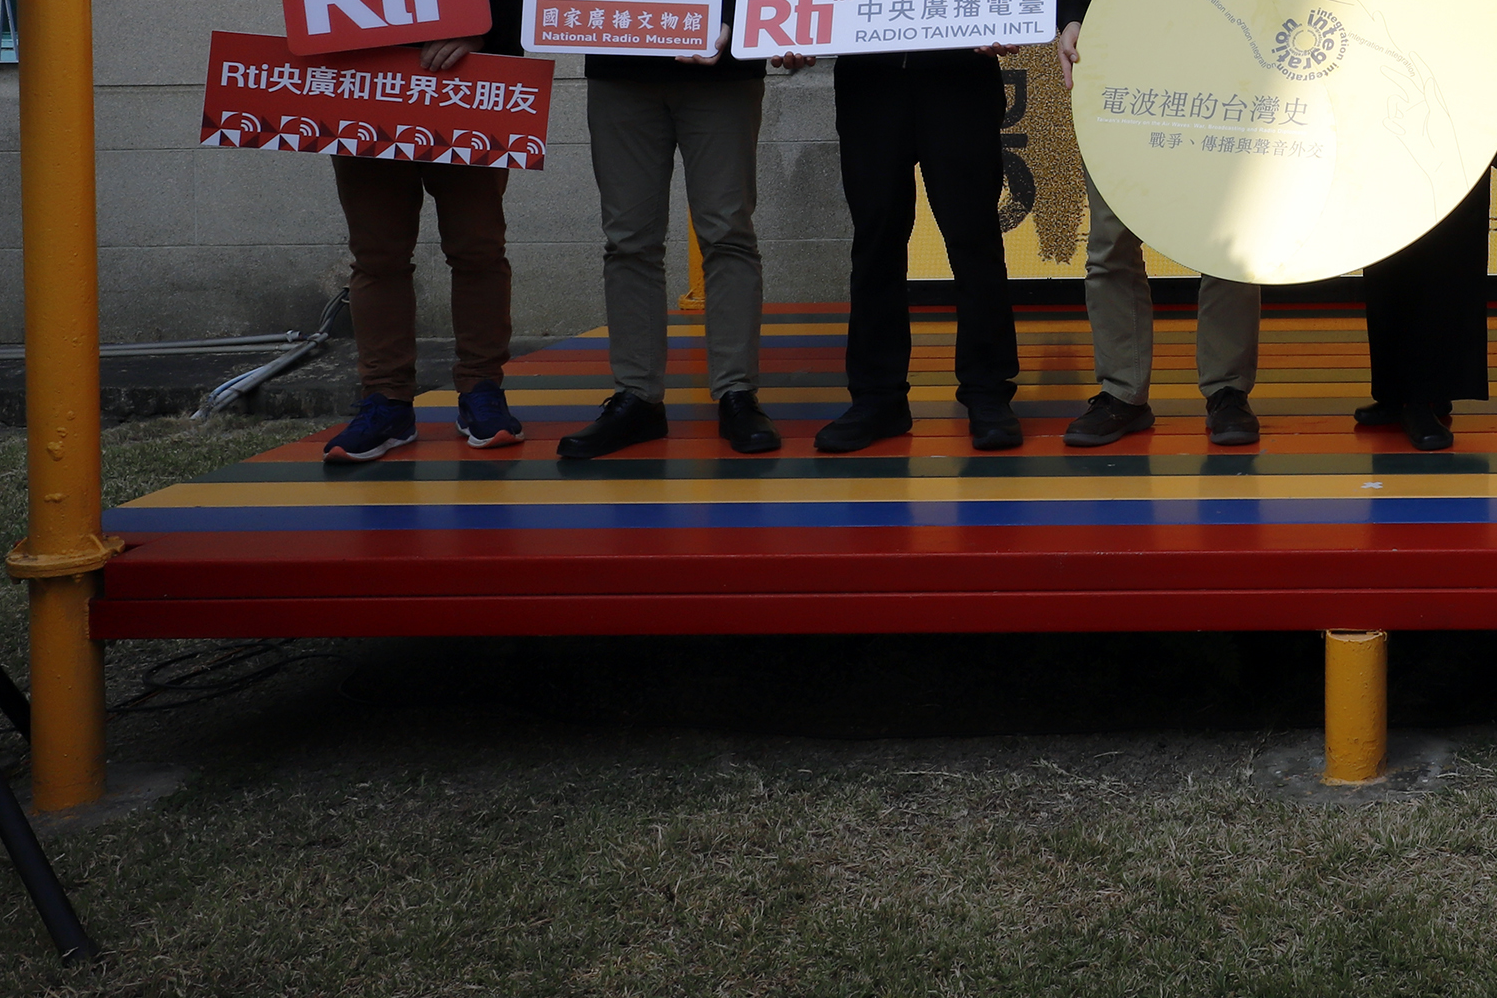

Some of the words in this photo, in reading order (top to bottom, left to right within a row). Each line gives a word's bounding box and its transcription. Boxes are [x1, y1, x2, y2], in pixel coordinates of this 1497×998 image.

[542, 7, 703, 32] 國家廣播文物館
[855, 27, 918, 43] RADIO
[921, 23, 996, 39] TAIWAN
[1003, 21, 1045, 35] INTL
[542, 31, 597, 42] National
[602, 33, 640, 43] Radio
[645, 34, 703, 45] Museum
[220, 61, 539, 115] Rti央廣和世界交朋友
[1101, 86, 1309, 127] 電波裡的台灣史
[1148, 131, 1324, 159] 戰爭、傳播與聲音外交
